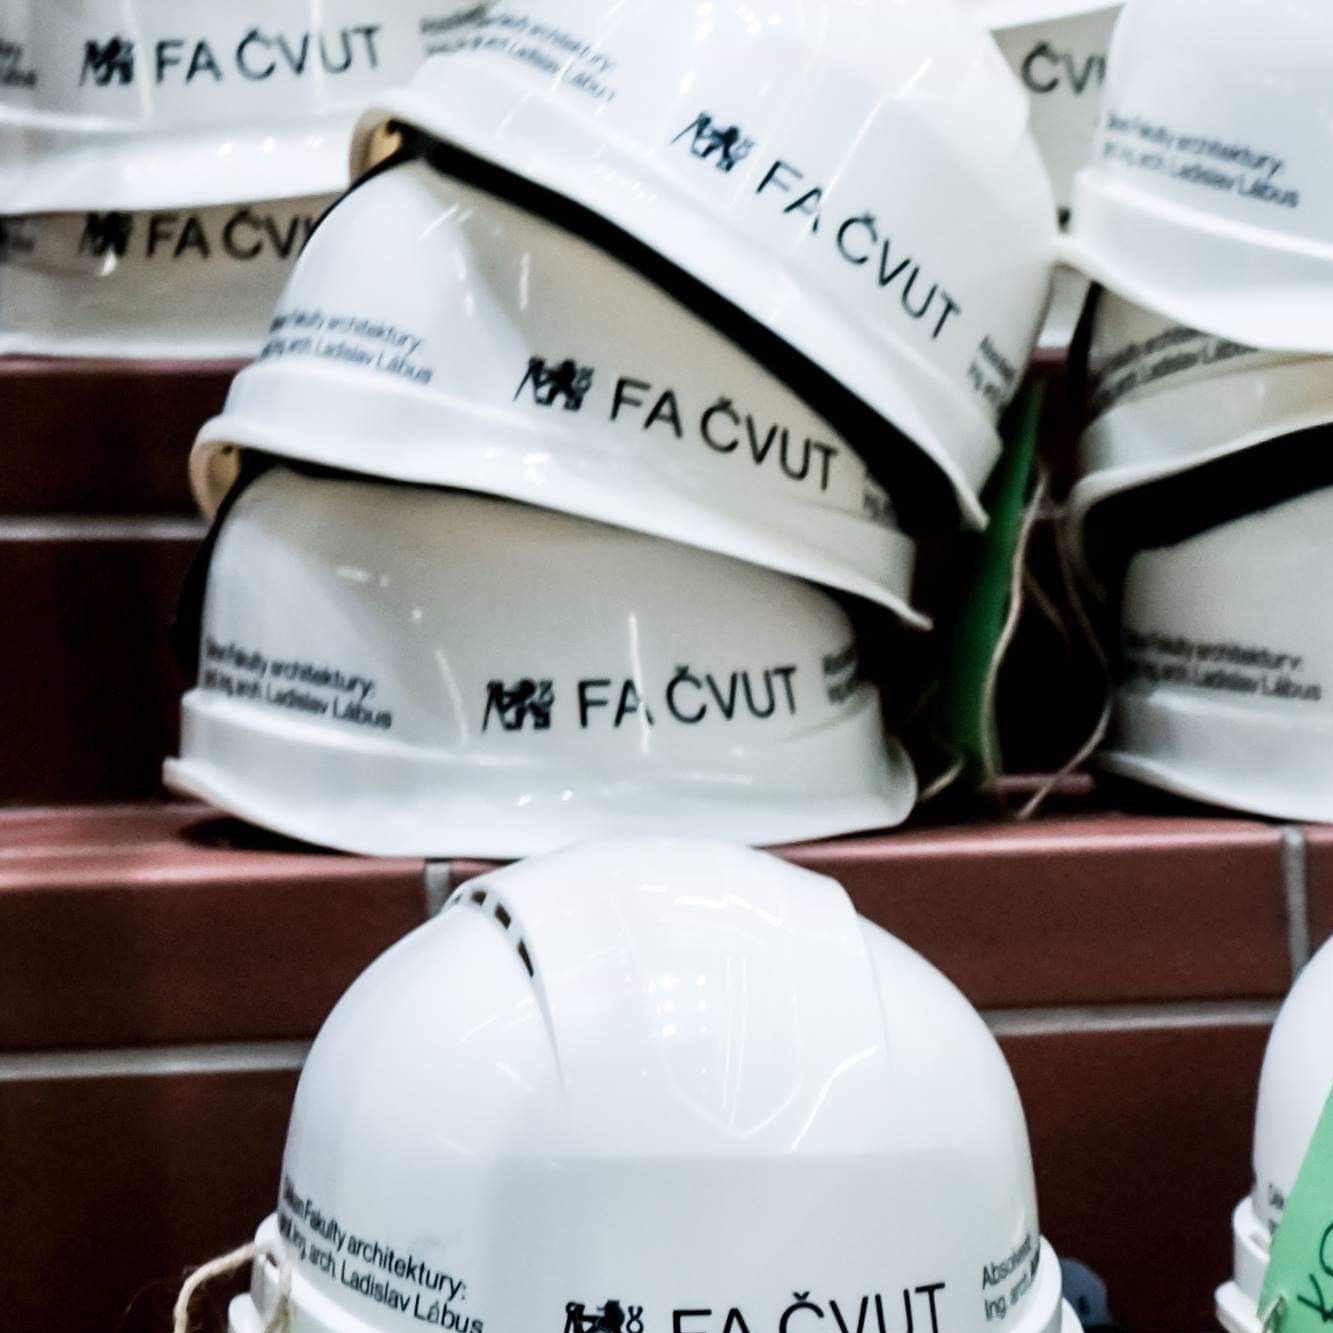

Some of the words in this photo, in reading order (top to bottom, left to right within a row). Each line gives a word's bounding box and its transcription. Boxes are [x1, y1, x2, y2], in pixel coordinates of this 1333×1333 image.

[155, 38, 223, 85] FA
[235, 23, 384, 81] ČVUT
[1020, 42, 1108, 96] ČV
[145, 214, 211, 260] FA
[221, 207, 322, 260] ČV
[756, 159, 825, 232] FA
[836, 210, 962, 341] ČVUT
[608, 377, 684, 441] FA
[699, 397, 839, 493] ČVUT
[577, 677, 653, 729] FA
[665, 664, 799, 725] ČVUT
[340, 1259, 412, 1313] Ladislav
[347, 1233, 468, 1303] architektury:
